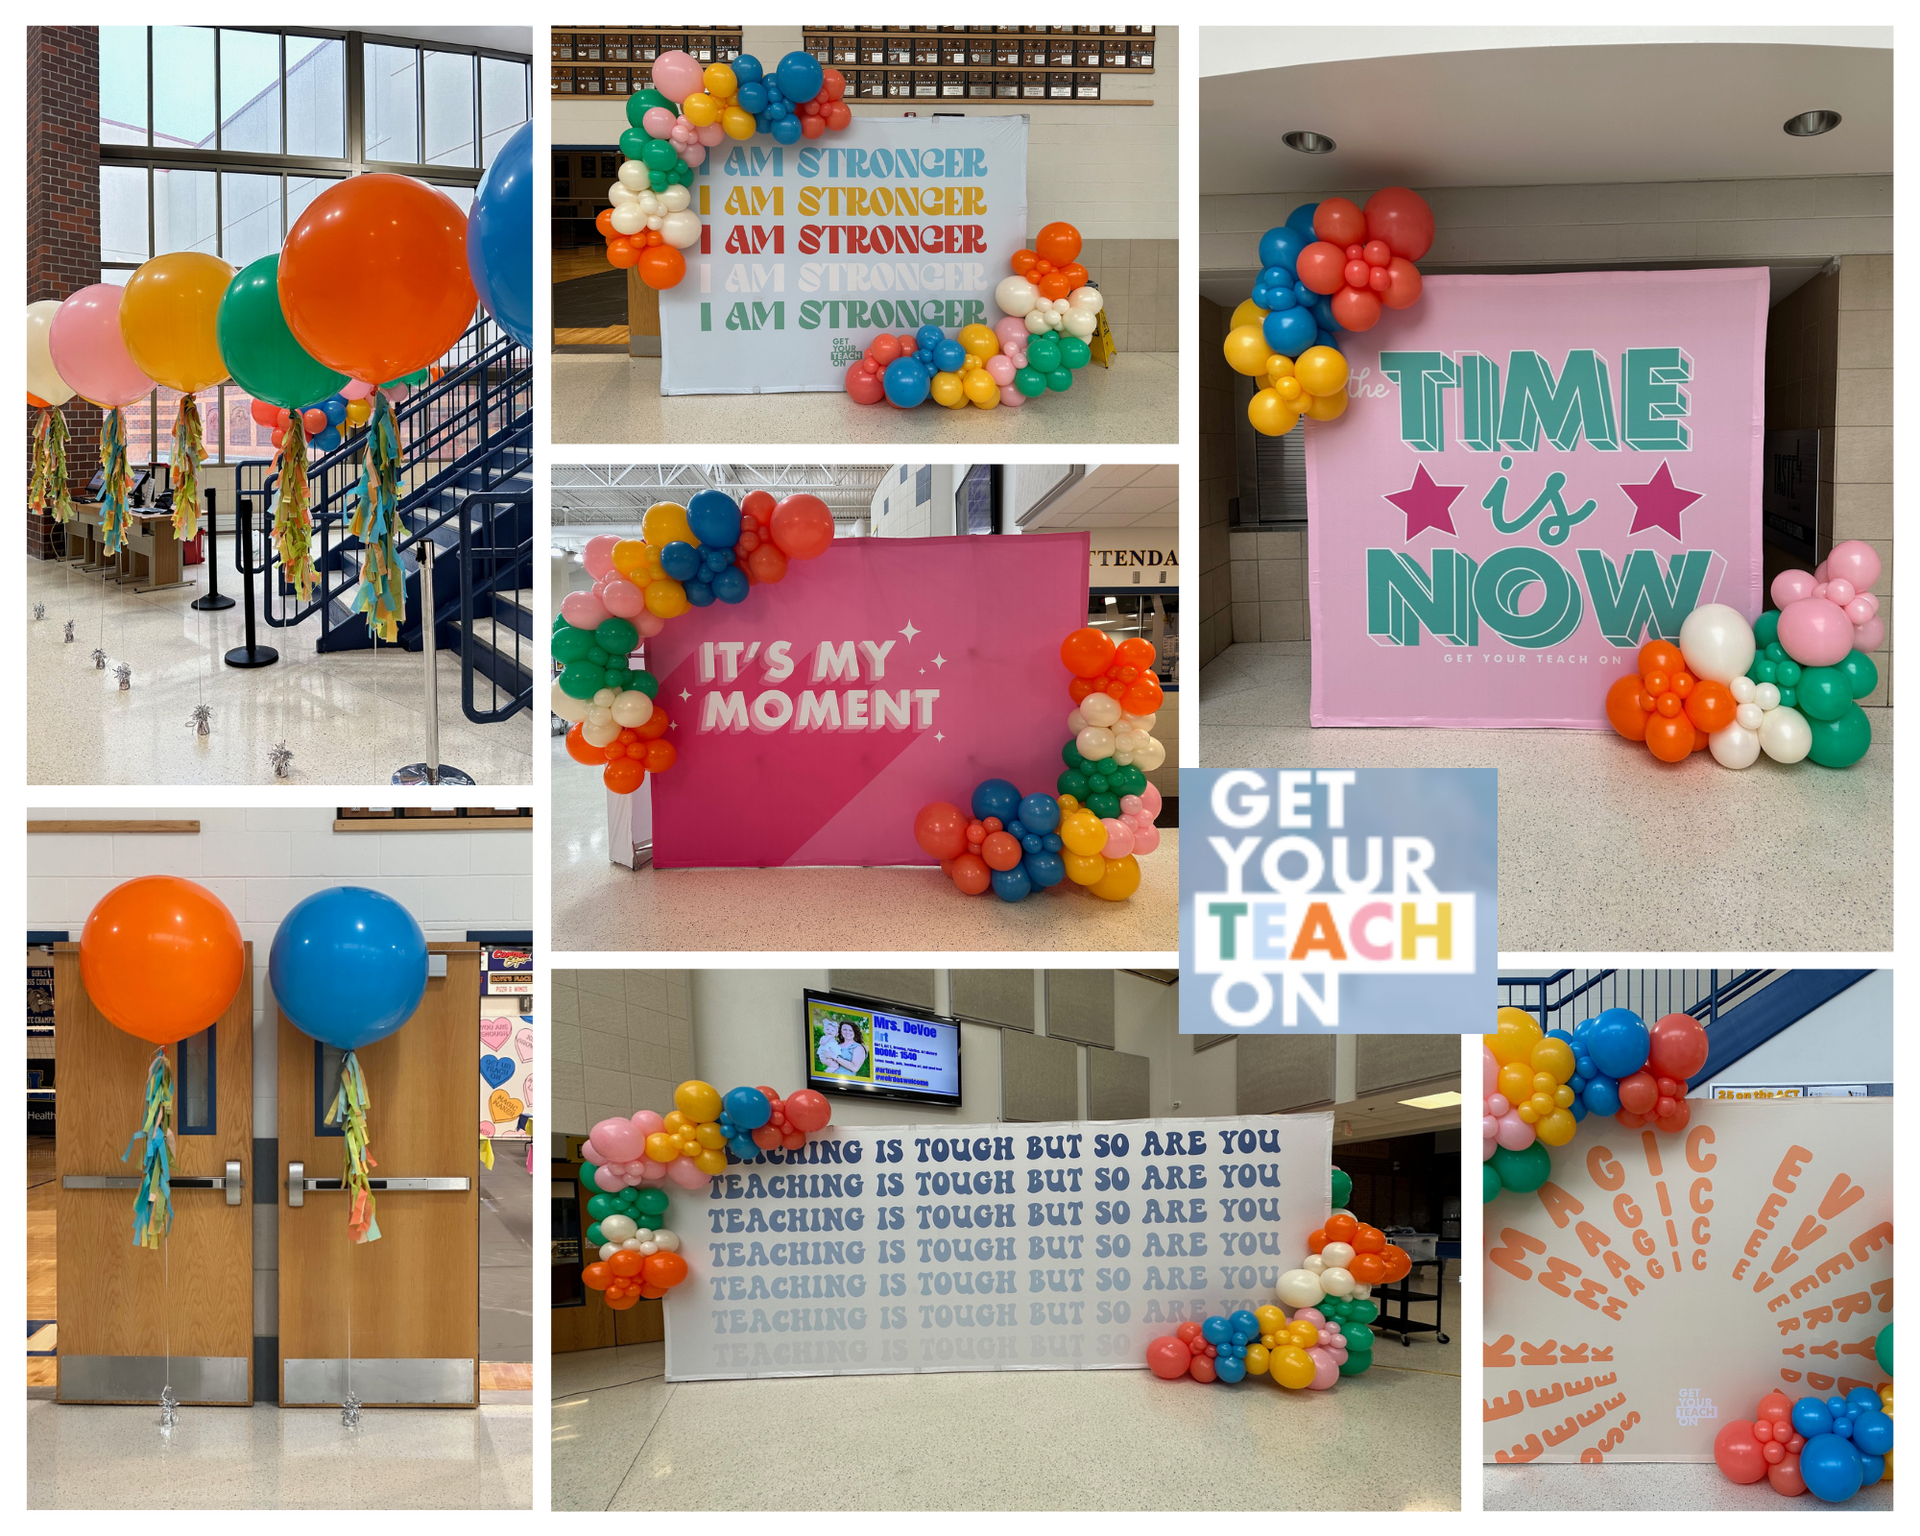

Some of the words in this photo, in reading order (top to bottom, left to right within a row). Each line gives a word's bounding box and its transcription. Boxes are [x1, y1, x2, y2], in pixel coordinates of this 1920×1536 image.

[699, 146, 711, 176] I
[724, 146, 784, 177] AM
[797, 147, 988, 178] STRONGER
[699, 185, 711, 216] I
[724, 186, 784, 216] AM
[798, 186, 988, 216] STRONGER
[700, 224, 711, 254] I
[725, 225, 784, 254] AM
[798, 224, 988, 255] STRONGER
[700, 264, 711, 293] I
[725, 263, 785, 293] AM
[798, 262, 988, 292] STRONGER
[701, 302, 712, 332] I
[726, 301, 785, 331] AM
[798, 299, 988, 330] STRONGER
[832, 352, 861, 360] TEACH
[1349, 366, 1390, 399] the
[1379, 347, 1694, 452] TIME
[1481, 455, 1599, 547] is
[1366, 546, 1728, 649] NOW
[811, 640, 897, 684] MY
[1444, 654, 1472, 663] GET
[1483, 654, 1526, 663] YOUR
[1537, 654, 1588, 664] TEACH
[1599, 656, 1622, 664] ON
[700, 688, 940, 732] MOMENT
[32, 970, 48, 978] GIRLS
[874, 1016, 900, 1032] Mrs.
[904, 1022, 937, 1038] DeVoe
[874, 1030, 888, 1042] Art
[486, 1059, 500, 1068] GET
[874, 1048, 898, 1058] ROOM:
[900, 1052, 918, 1061] 1540
[486, 1065, 510, 1076] TEACH
[875, 1066, 902, 1076] #artnerd
[876, 1075, 929, 1086] #weirdoswelcome
[492, 1098, 516, 1118] MAKER
[496, 1094, 518, 1112] MAGIC
[1718, 1090, 1734, 1098] 25
[1754, 1090, 1774, 1098] the
[1776, 1090, 1800, 1098] ACT
[875, 1139, 904, 1163] IS
[915, 1137, 1016, 1163] TOUGH
[1026, 1134, 1082, 1160] BUT
[1094, 1133, 1130, 1158] SO
[1141, 1131, 1207, 1156] ARE
[1218, 1129, 1281, 1154] YOU
[709, 1174, 864, 1199] TEACHING
[876, 1172, 904, 1197] IS
[916, 1170, 1016, 1196] TOUGH
[1026, 1167, 1083, 1193] BUT
[1094, 1166, 1130, 1191] SO
[1142, 1164, 1207, 1190] ARE
[1219, 1163, 1281, 1188] YOU
[708, 1207, 865, 1233] TEACHING
[877, 1206, 905, 1230] IS
[916, 1204, 1016, 1230] TOUGH
[1028, 1201, 1084, 1226] BUT
[1095, 1200, 1130, 1224] SO
[1142, 1198, 1208, 1224] ARE
[1219, 1198, 1281, 1222] YOU
[1490, 1125, 1717, 1281] MAGIC
[709, 1240, 866, 1267] TEACHING
[878, 1240, 906, 1264] IS
[916, 1238, 1016, 1263] TOUGH
[1028, 1234, 1084, 1260] BUT
[1096, 1234, 1131, 1258] SO
[1142, 1232, 1208, 1257] ARE
[1220, 1232, 1281, 1256] YOU
[1538, 1177, 1714, 1298] MAGIC
[710, 1274, 867, 1300] TEACHING
[879, 1273, 906, 1297] IS
[918, 1271, 1017, 1296] TOUGH
[1028, 1268, 1084, 1293] BUT
[1096, 1267, 1131, 1292] SO
[1142, 1266, 1208, 1290] ARE
[1220, 1265, 1280, 1290] YOU
[712, 1307, 868, 1334] TEACHING
[880, 1306, 908, 1330] IS
[918, 1304, 1018, 1330] TOUGH
[1030, 1300, 1085, 1326] BUT
[1096, 1300, 1132, 1324] SO
[1142, 1299, 1207, 1324] ARE
[1573, 1216, 1711, 1310] MAGIC
[1744, 1229, 1839, 1391] EVERYD
[1602, 1248, 1707, 1321] MAGIC
[1732, 1258, 1805, 1383] EVERYD
[1678, 1388, 1701, 1398] GET
[1678, 1398, 1712, 1407] YOUR
[1678, 1408, 1715, 1417] TEACH
[1678, 1418, 1698, 1426] ON
